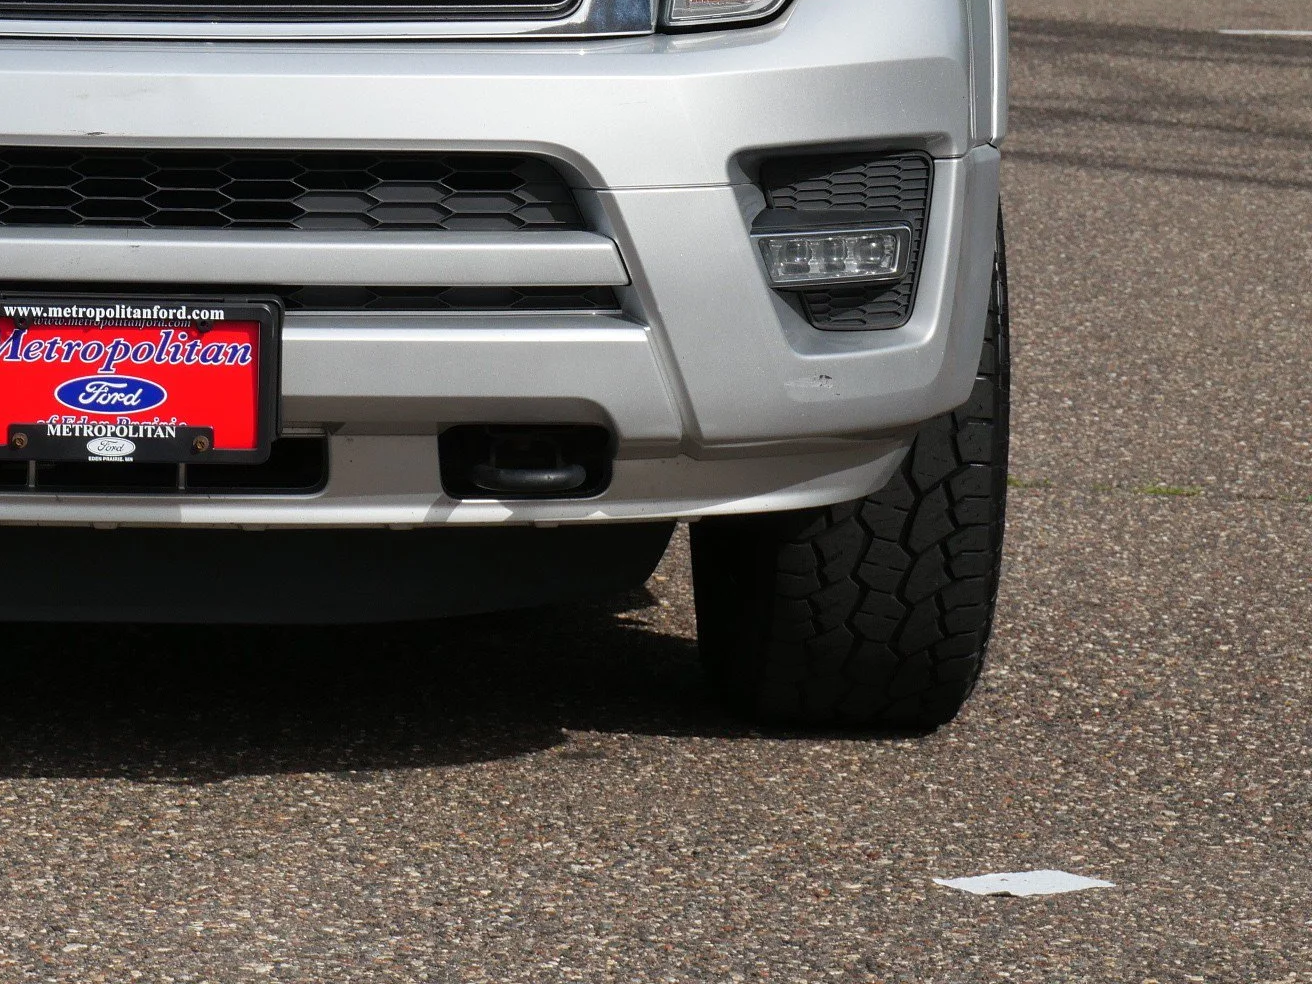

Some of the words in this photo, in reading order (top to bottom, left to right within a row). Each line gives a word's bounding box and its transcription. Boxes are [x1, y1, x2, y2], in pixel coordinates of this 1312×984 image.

[3, 304, 225, 322] www.metropolitanford.com
[78, 380, 143, 407] Ford
[46, 423, 177, 438] METROPOLITAN
[97, 439, 125, 452] Ford
